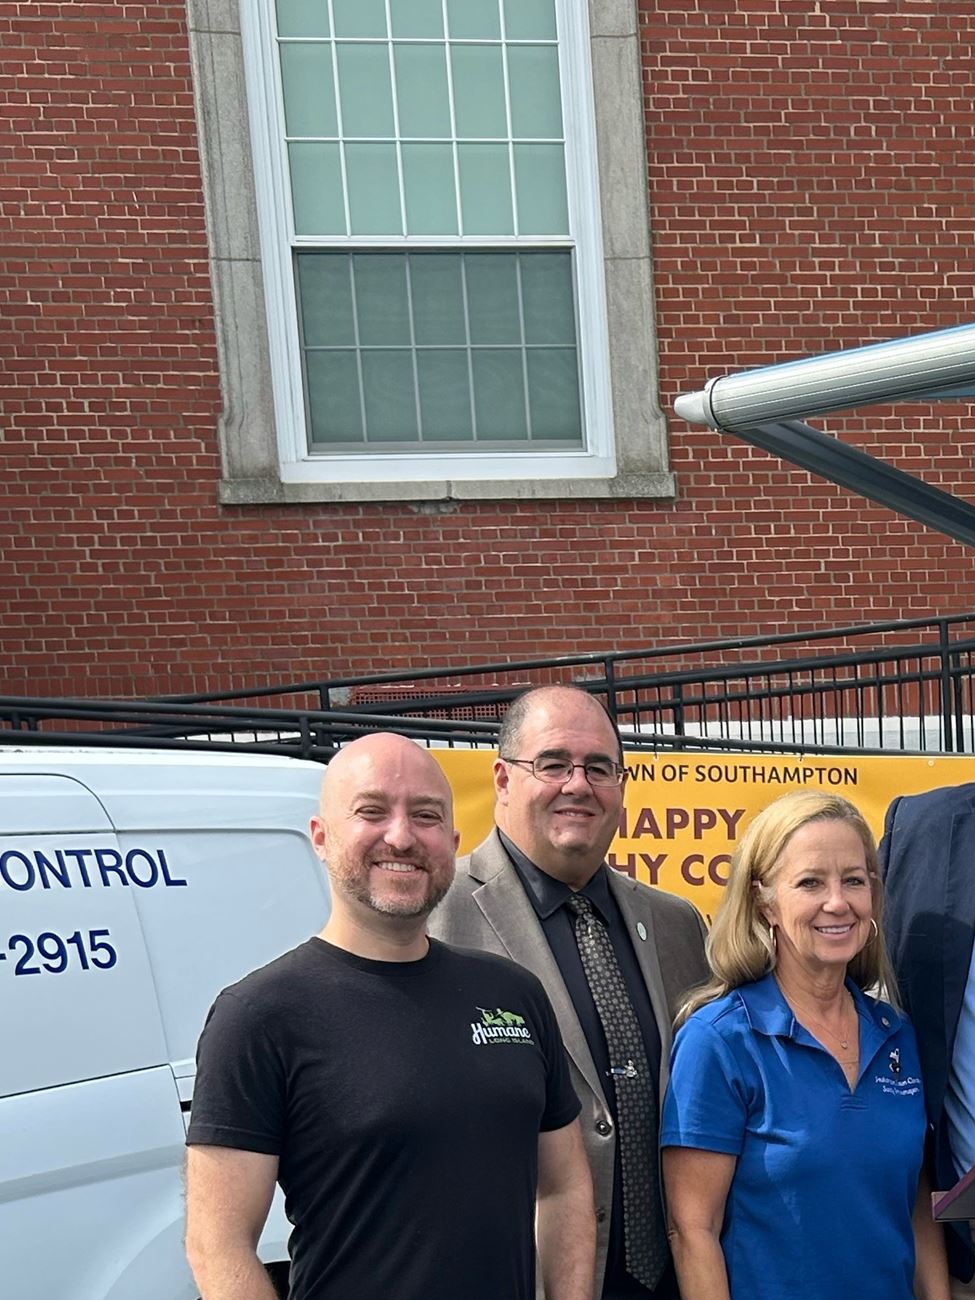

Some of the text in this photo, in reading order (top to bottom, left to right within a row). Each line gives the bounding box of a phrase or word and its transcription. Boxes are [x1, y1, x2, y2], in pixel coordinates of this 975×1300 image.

[627, 764, 858, 785] WN OF SOUTHAMPTON
[0, 848, 187, 891] ONTROL
[608, 853, 734, 887] HY CO
[471, 1022, 531, 1045] Humane
